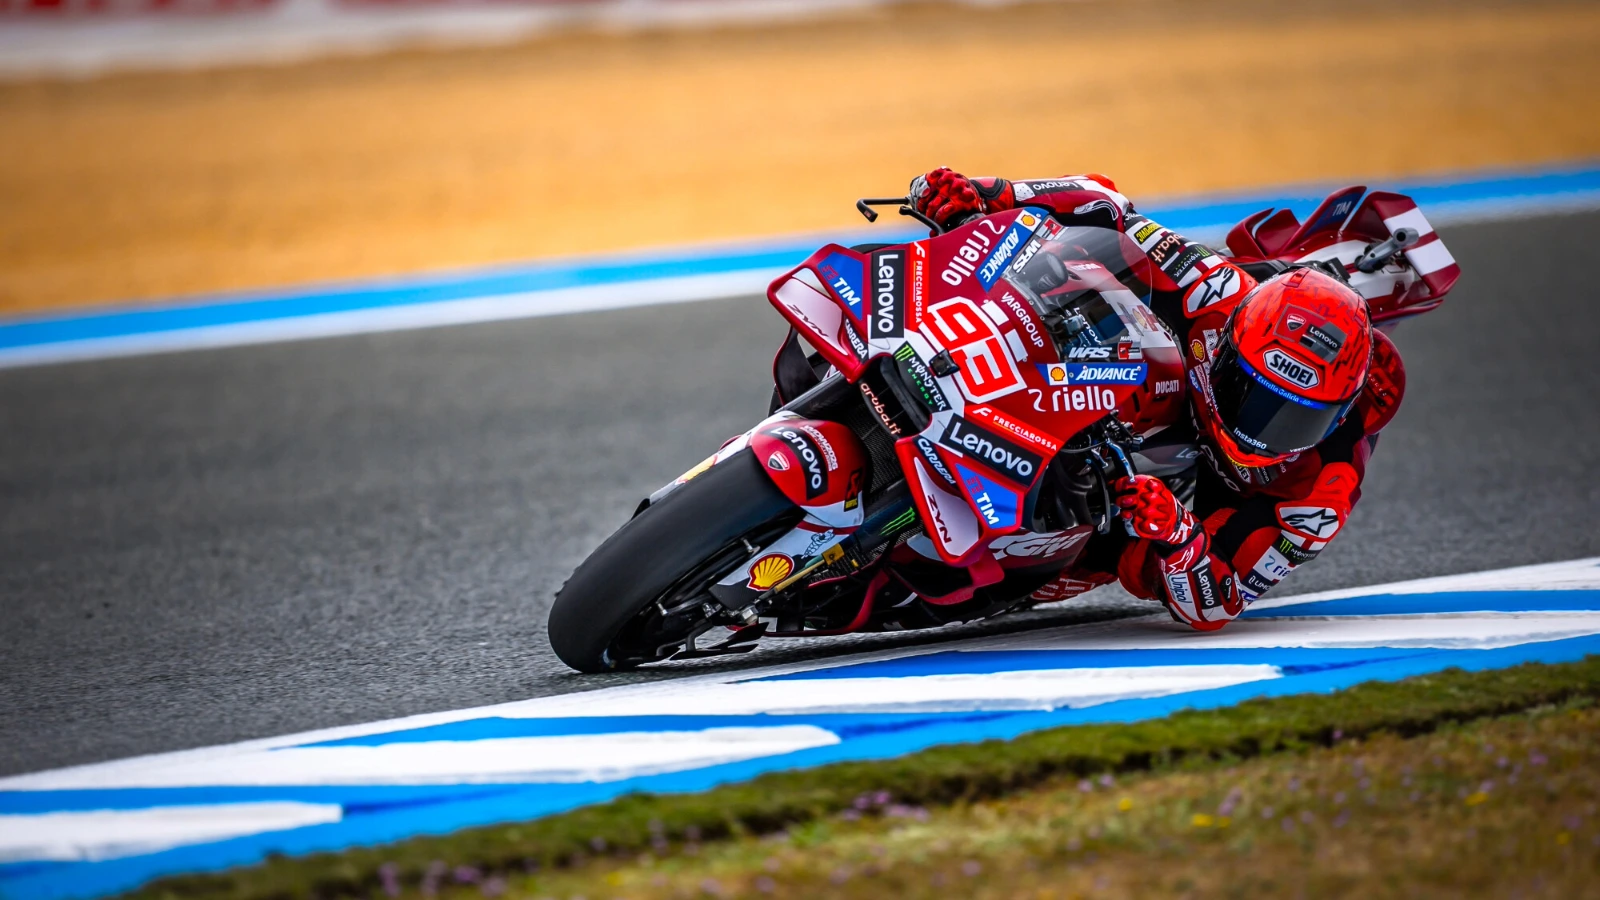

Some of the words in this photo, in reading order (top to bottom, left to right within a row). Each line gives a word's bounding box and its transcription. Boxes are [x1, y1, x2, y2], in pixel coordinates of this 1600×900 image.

[1032, 181, 1078, 190] Lenovo
[941, 230, 991, 286] riello
[980, 228, 1020, 282] ADVANCE
[1012, 239, 1042, 273] WRS
[1151, 233, 1183, 263] uba.it
[833, 277, 861, 306] TIM
[878, 254, 899, 333] Lenovo
[915, 260, 923, 323] FRECCIAROSSA
[786, 303, 829, 338] ZYN
[1001, 291, 1044, 348] VARGROUP
[1309, 326, 1338, 349] Lenovo
[920, 298, 1026, 403] 93
[1069, 346, 1112, 359] WRS
[907, 368, 933, 405] ENERGY
[908, 355, 946, 412] MONSTER
[1075, 367, 1139, 382] ADVANCE
[1155, 379, 1179, 395] DUCATI
[1269, 353, 1314, 386] SHOEI
[860, 382, 902, 435] aruba.it
[1051, 385, 1116, 412] riello
[949, 421, 1033, 477] Lenovo
[992, 415, 1057, 451] FRECCIAROSSA
[1233, 427, 1267, 450] Insta360
[770, 426, 822, 489] Lenovo
[917, 438, 957, 485] CARRERA
[927, 494, 952, 544] ZYN
[976, 492, 1000, 525] TIM
[1198, 567, 1215, 606] Lenovo
[1272, 565, 1291, 577] rie
